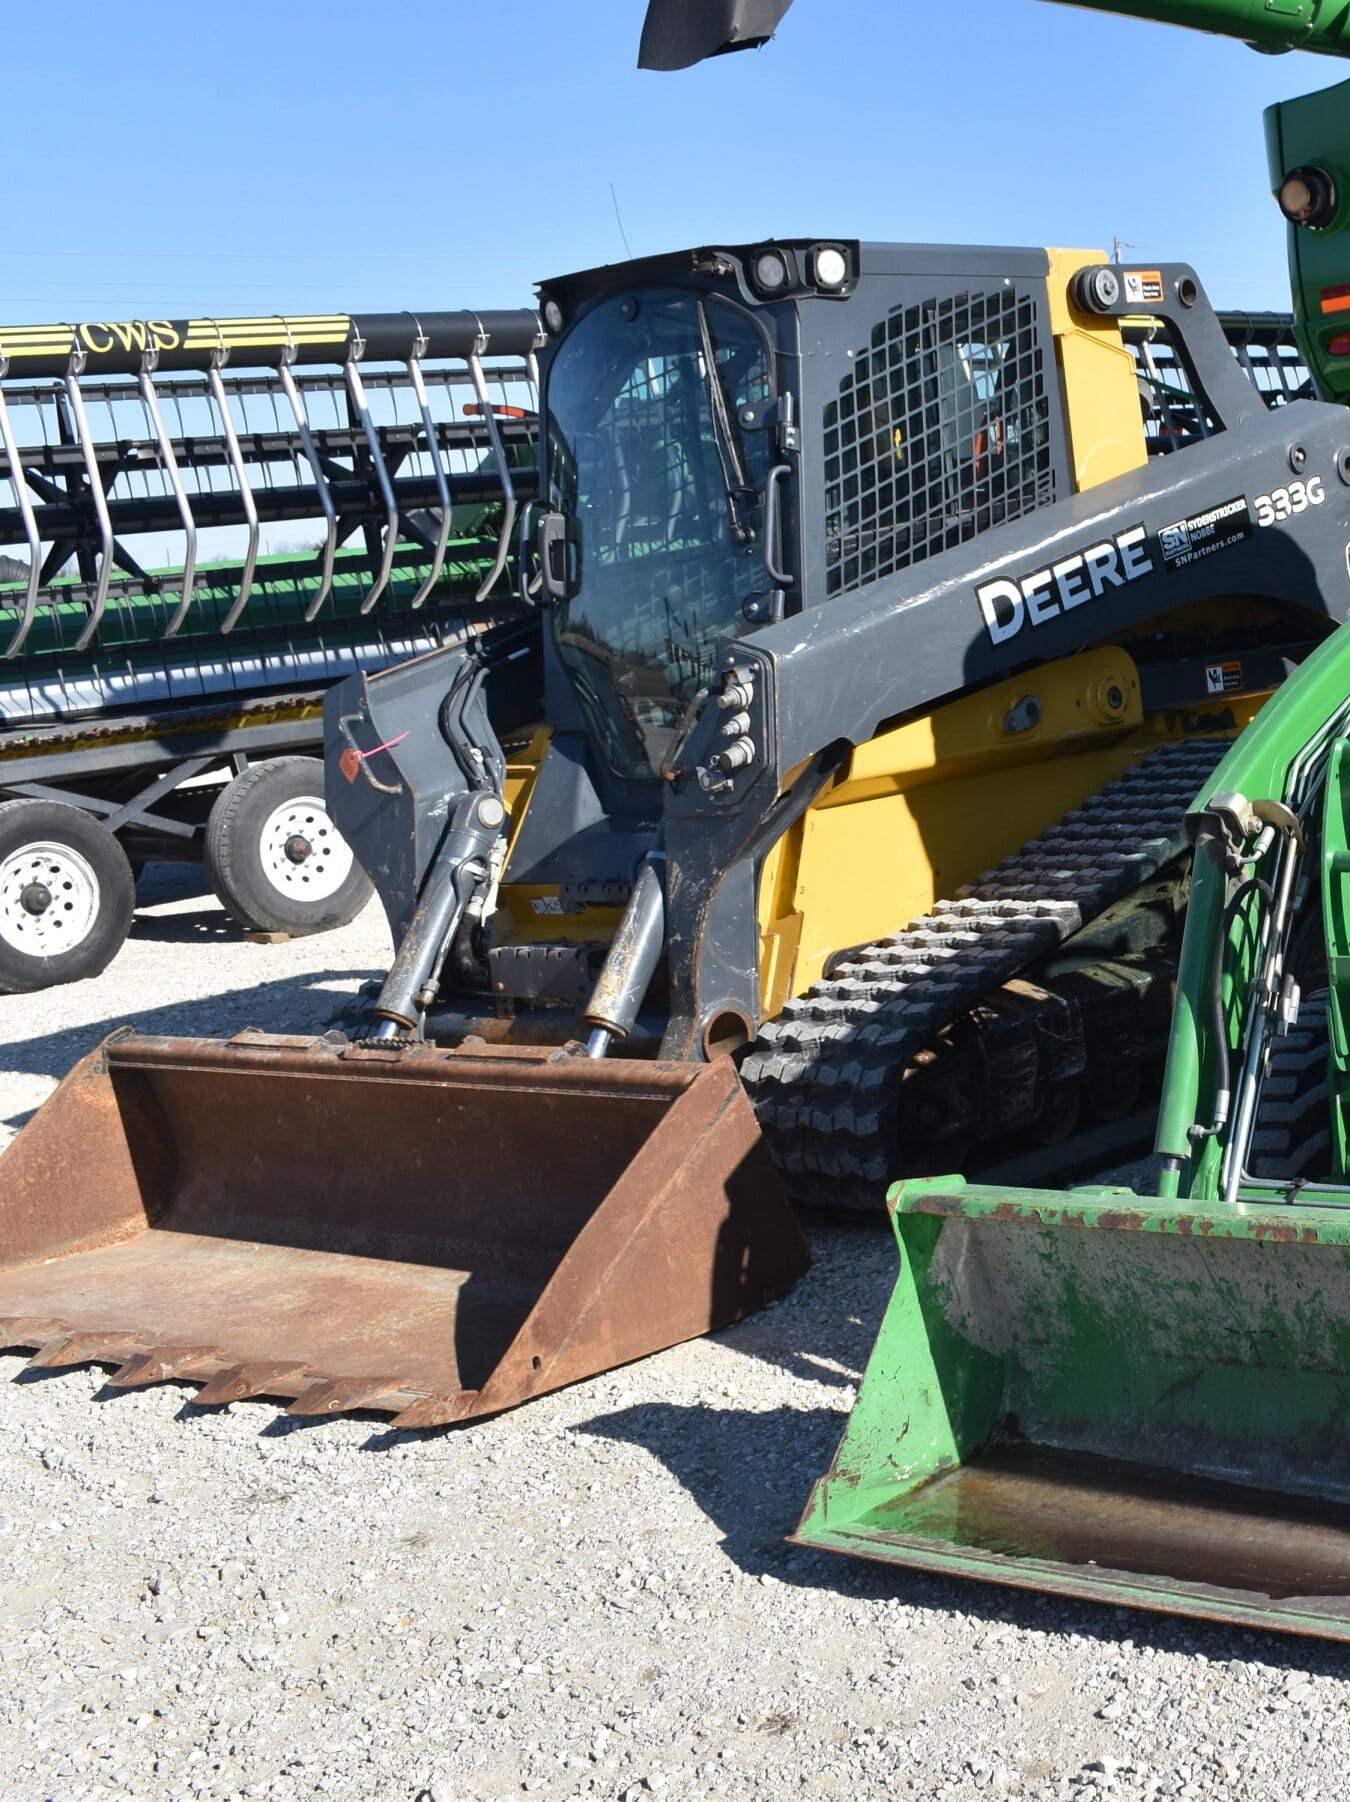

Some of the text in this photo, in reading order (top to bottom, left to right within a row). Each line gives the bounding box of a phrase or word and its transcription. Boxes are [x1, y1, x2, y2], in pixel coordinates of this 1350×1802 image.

[80, 320, 180, 353] CWS
[1254, 476, 1326, 528] 333G
[1162, 524, 1189, 550] SN
[1174, 530, 1245, 568] SNPartners.com
[1190, 524, 1216, 543] NOBBE
[976, 525, 1154, 646] DEERE
